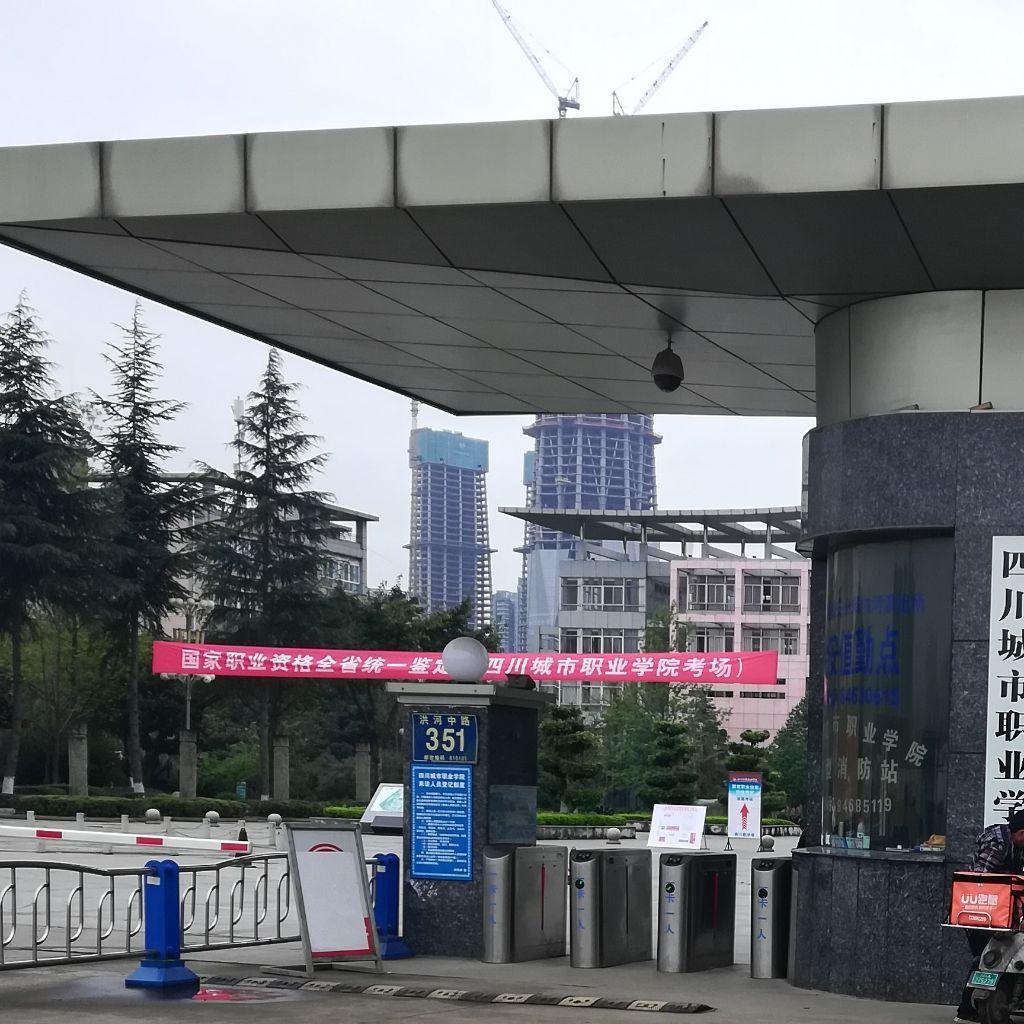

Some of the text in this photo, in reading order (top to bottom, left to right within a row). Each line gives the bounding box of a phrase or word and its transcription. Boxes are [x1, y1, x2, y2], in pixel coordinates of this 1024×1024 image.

[419, 714, 470, 726] 洪河中路
[425, 727, 465, 752] 351
